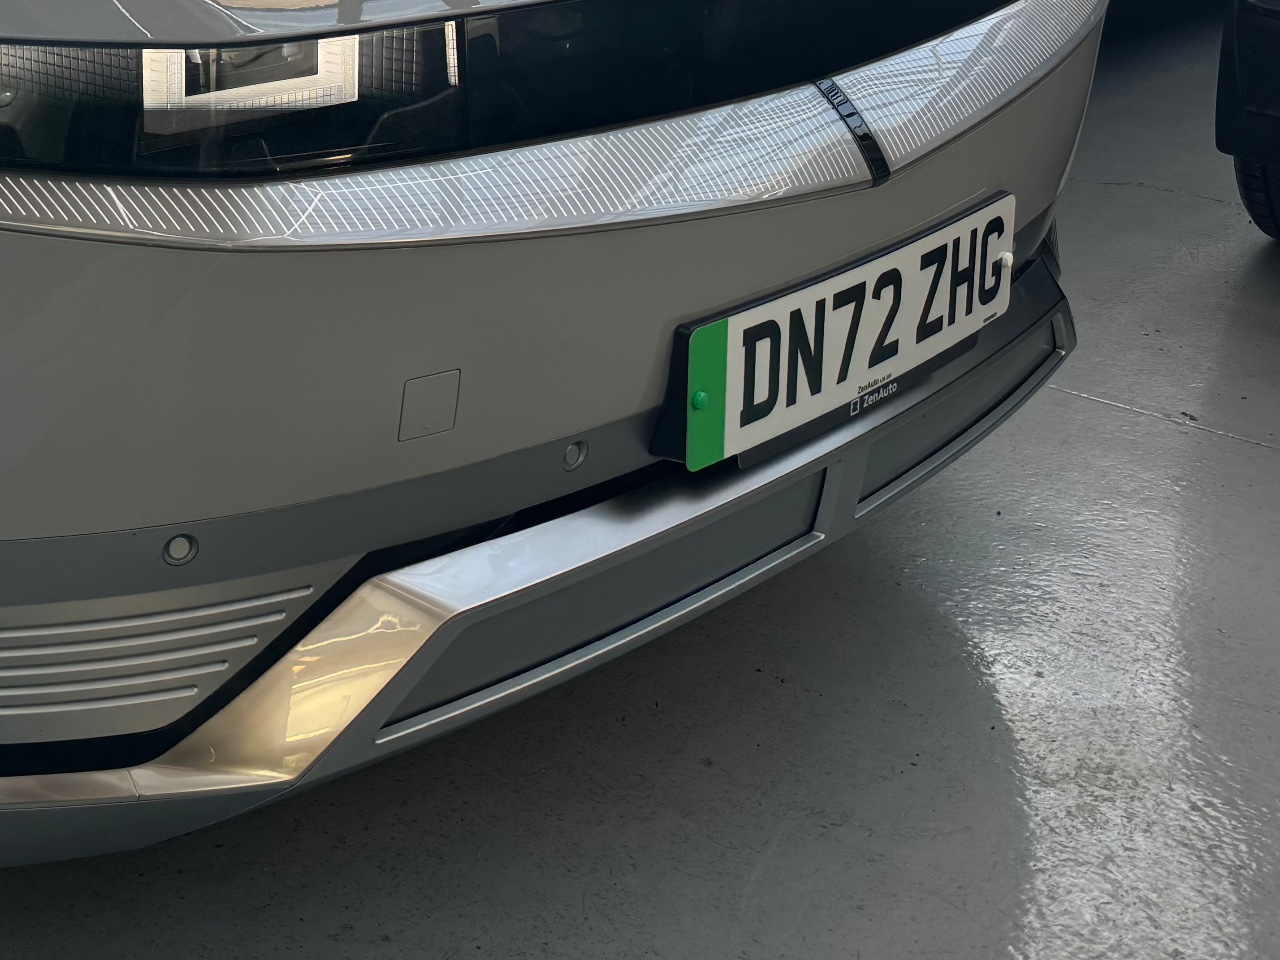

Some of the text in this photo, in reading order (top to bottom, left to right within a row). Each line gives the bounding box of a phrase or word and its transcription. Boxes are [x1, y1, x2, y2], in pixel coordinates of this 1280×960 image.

[739, 215, 1006, 429] DN72 ZHG
[857, 378, 880, 394] ZenAuto
[862, 382, 898, 408] ZenAuto
